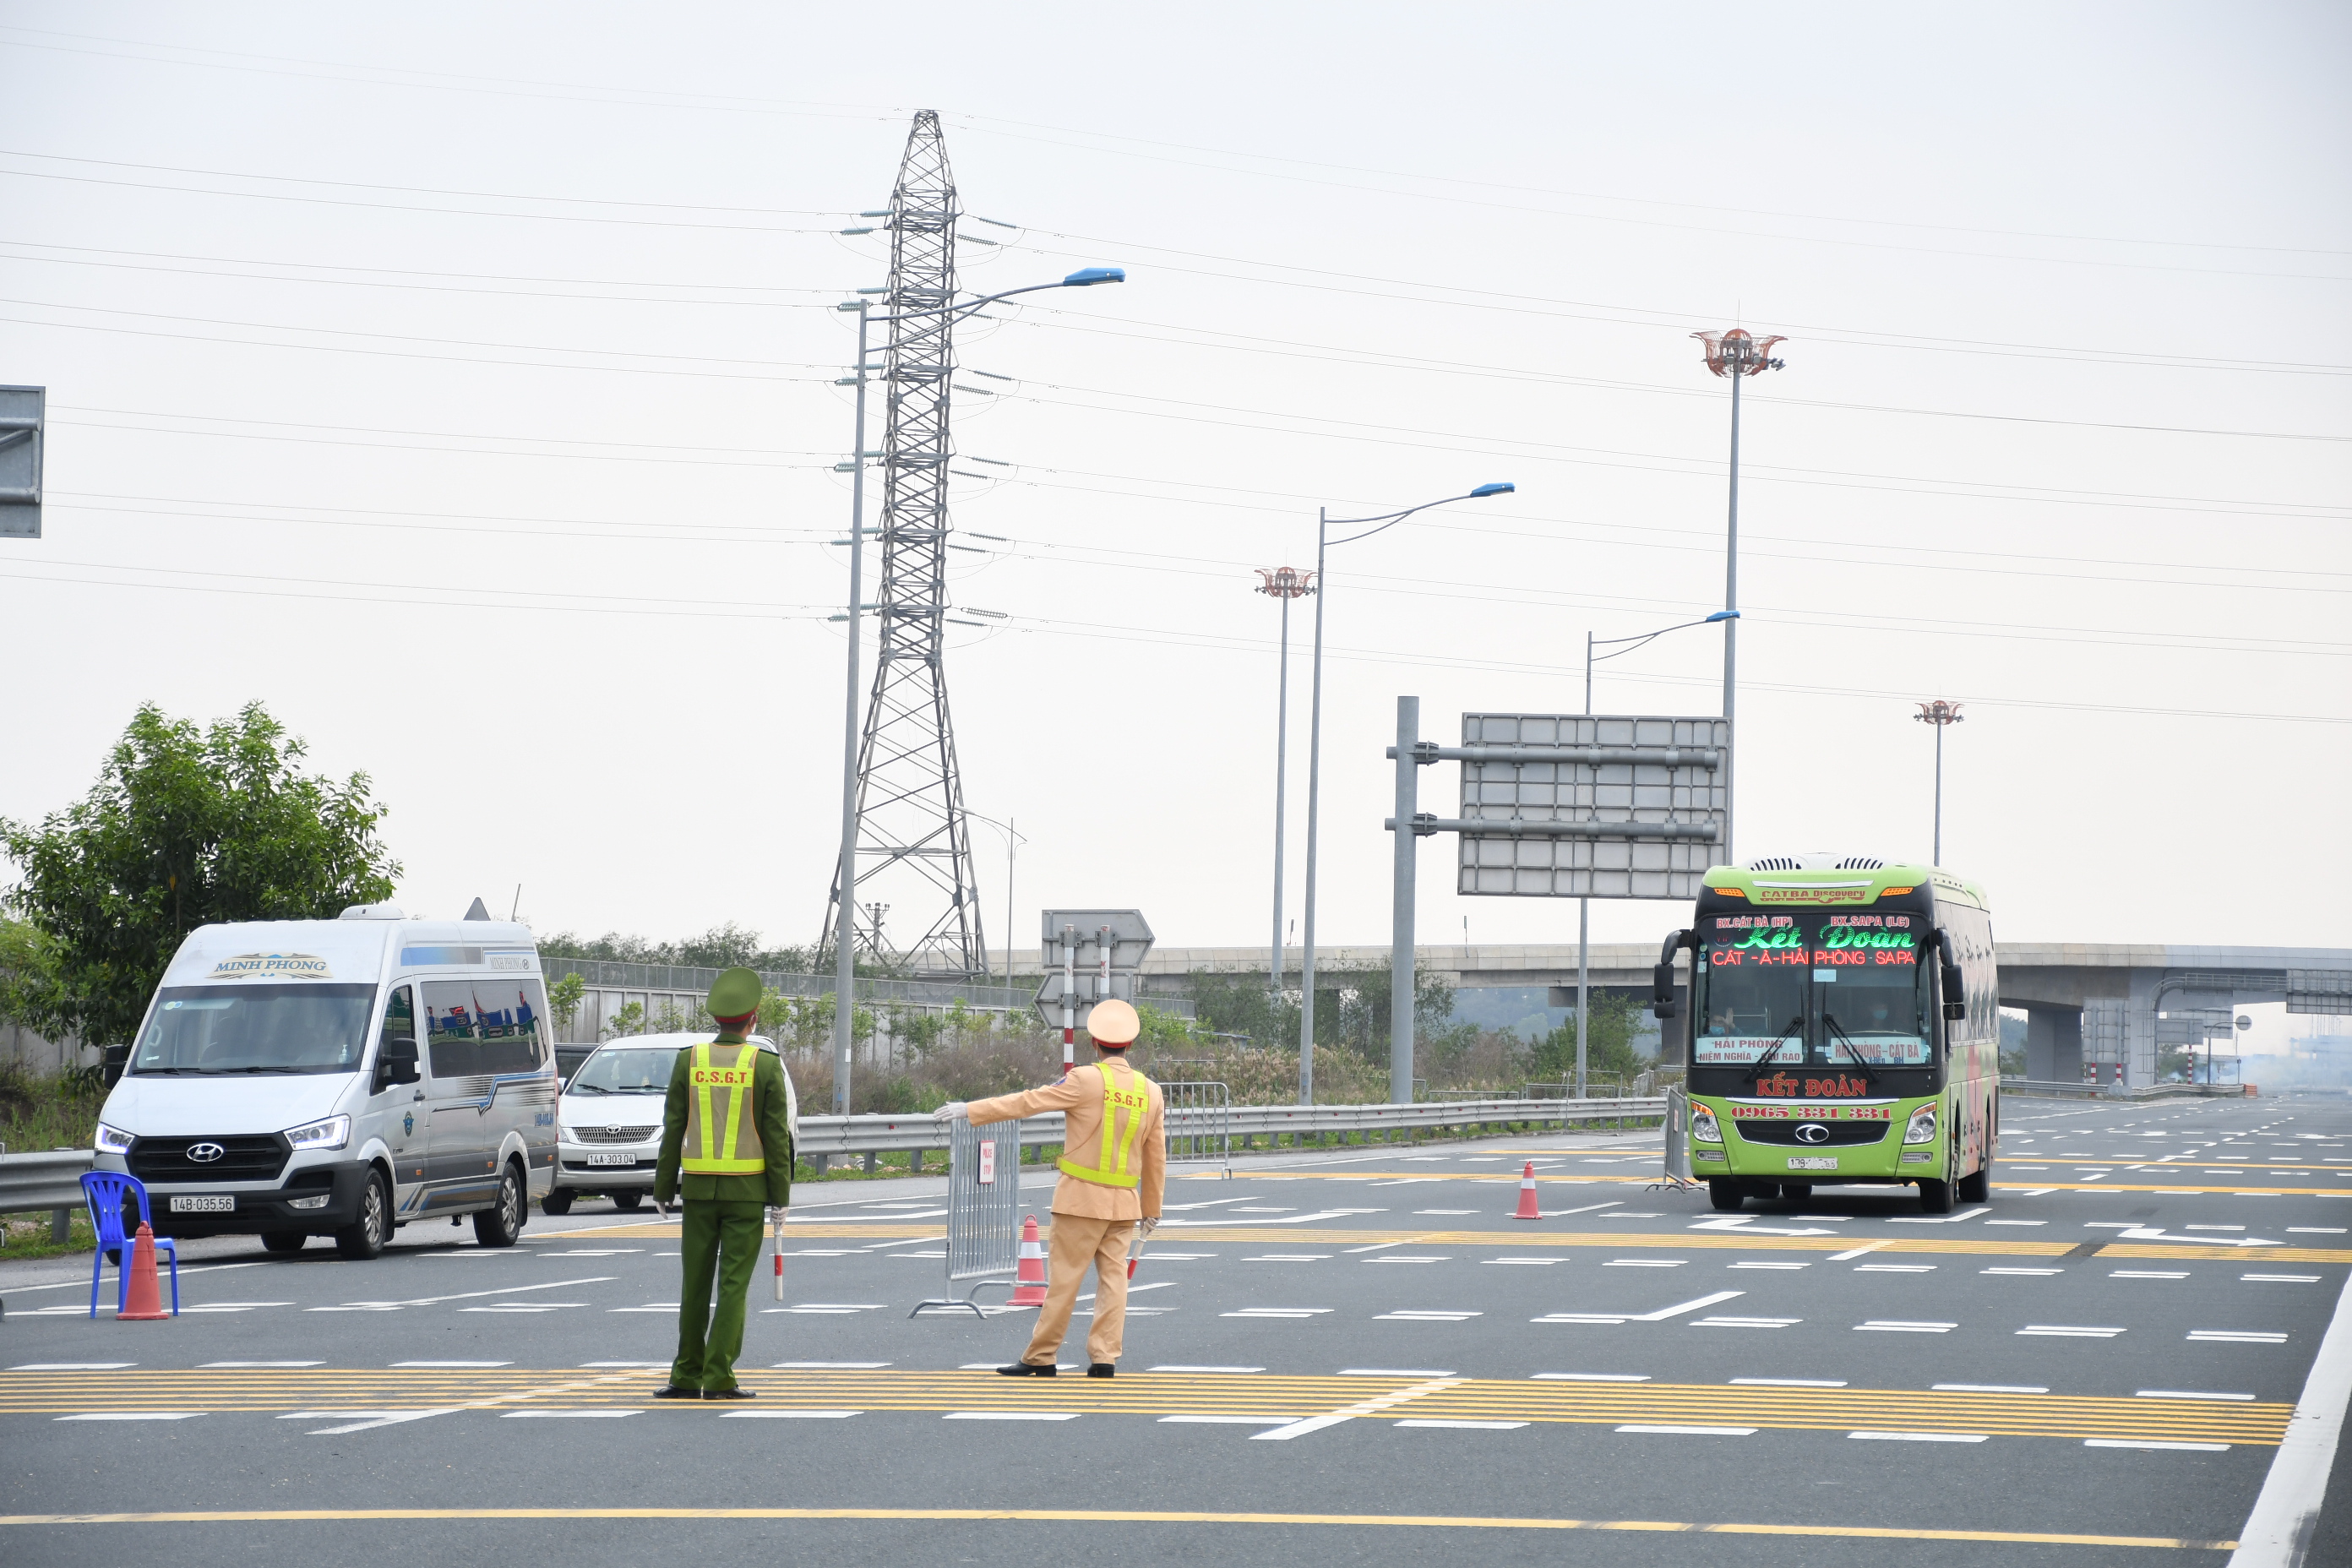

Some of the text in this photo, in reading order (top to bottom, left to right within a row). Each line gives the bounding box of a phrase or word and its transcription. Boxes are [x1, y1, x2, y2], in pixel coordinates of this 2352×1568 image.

[1717, 915, 1793, 928] BX.CÁT BÀ (HP)
[1831, 916, 1910, 928] BX.SAPA (LC)
[1815, 949, 1865, 965] PHÒNG
[214, 960, 327, 972] MINH PHONG
[695, 1070, 748, 1084] C.S.G.T
[1756, 1071, 1867, 1097] KẾT ĐOÀN
[1731, 1106, 1893, 1119] 0965 331 331
[590, 1154, 634, 1164] 14A-303.04
[173, 1198, 232, 1211] 14B-035.56
